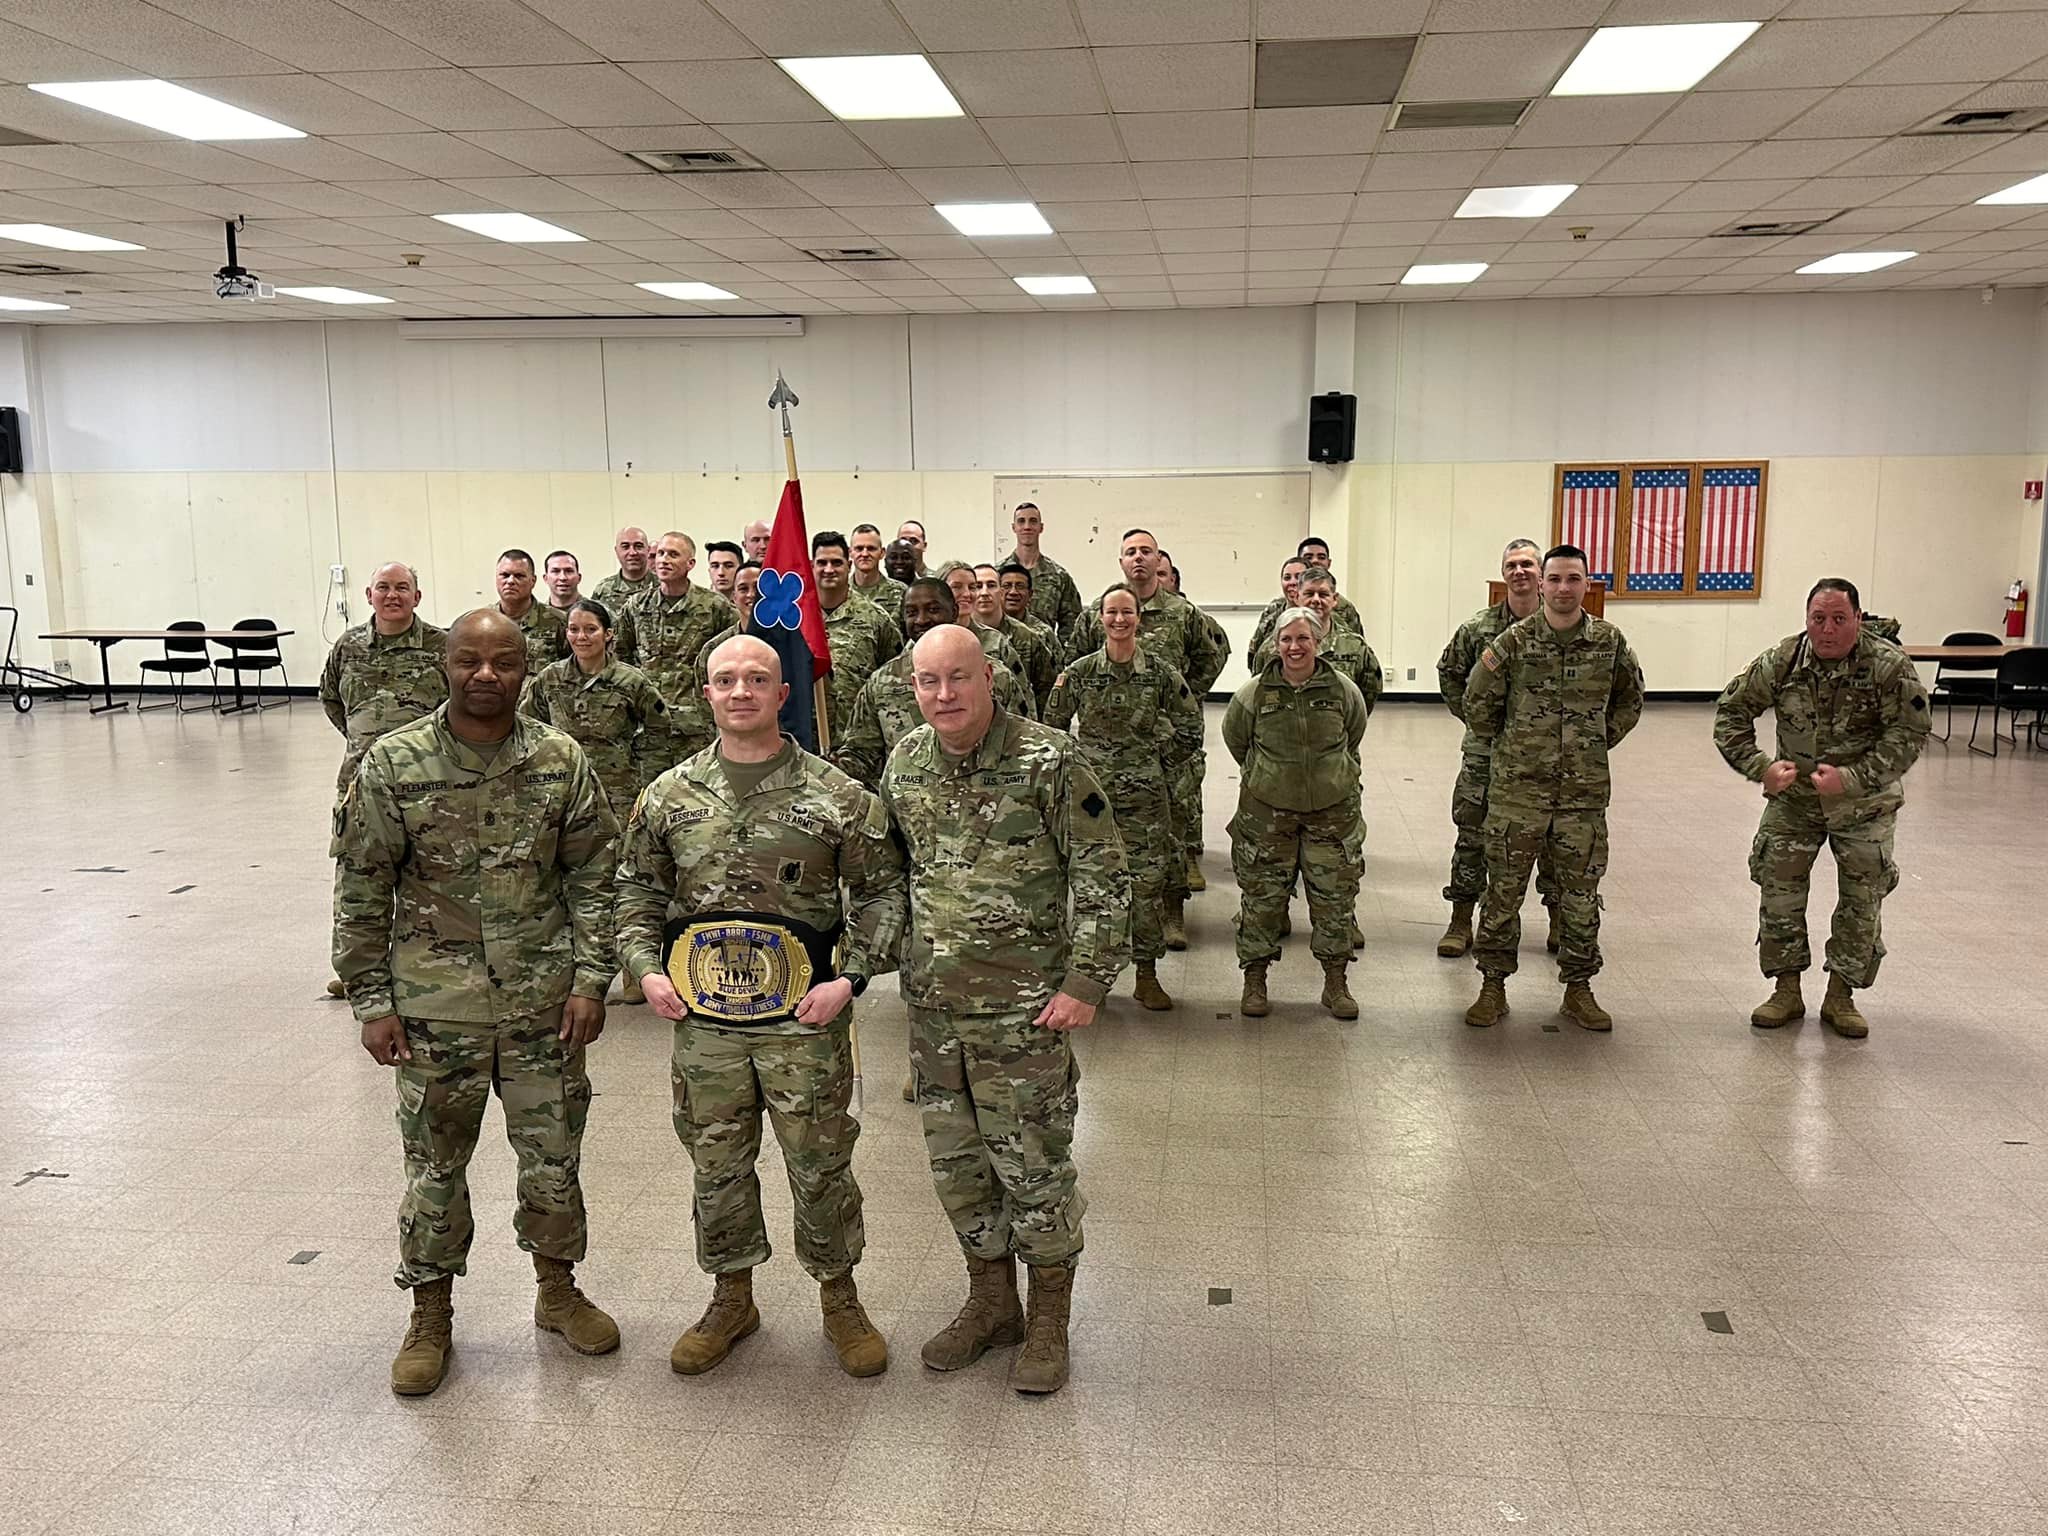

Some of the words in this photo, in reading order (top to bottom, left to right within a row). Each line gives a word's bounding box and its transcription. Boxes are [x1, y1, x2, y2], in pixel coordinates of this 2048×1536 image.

[544, 772, 567, 783] ARMY
[901, 775, 923, 785] BAKER
[1004, 775, 1027, 785] ARMY
[402, 780, 447, 793] FLEMISTER
[670, 808, 710, 824] MESSENGER
[791, 815, 816, 830] ARMY
[719, 986, 738, 995] BLUE
[738, 986, 759, 995] DEVIL
[703, 999, 722, 1012] ARMY
